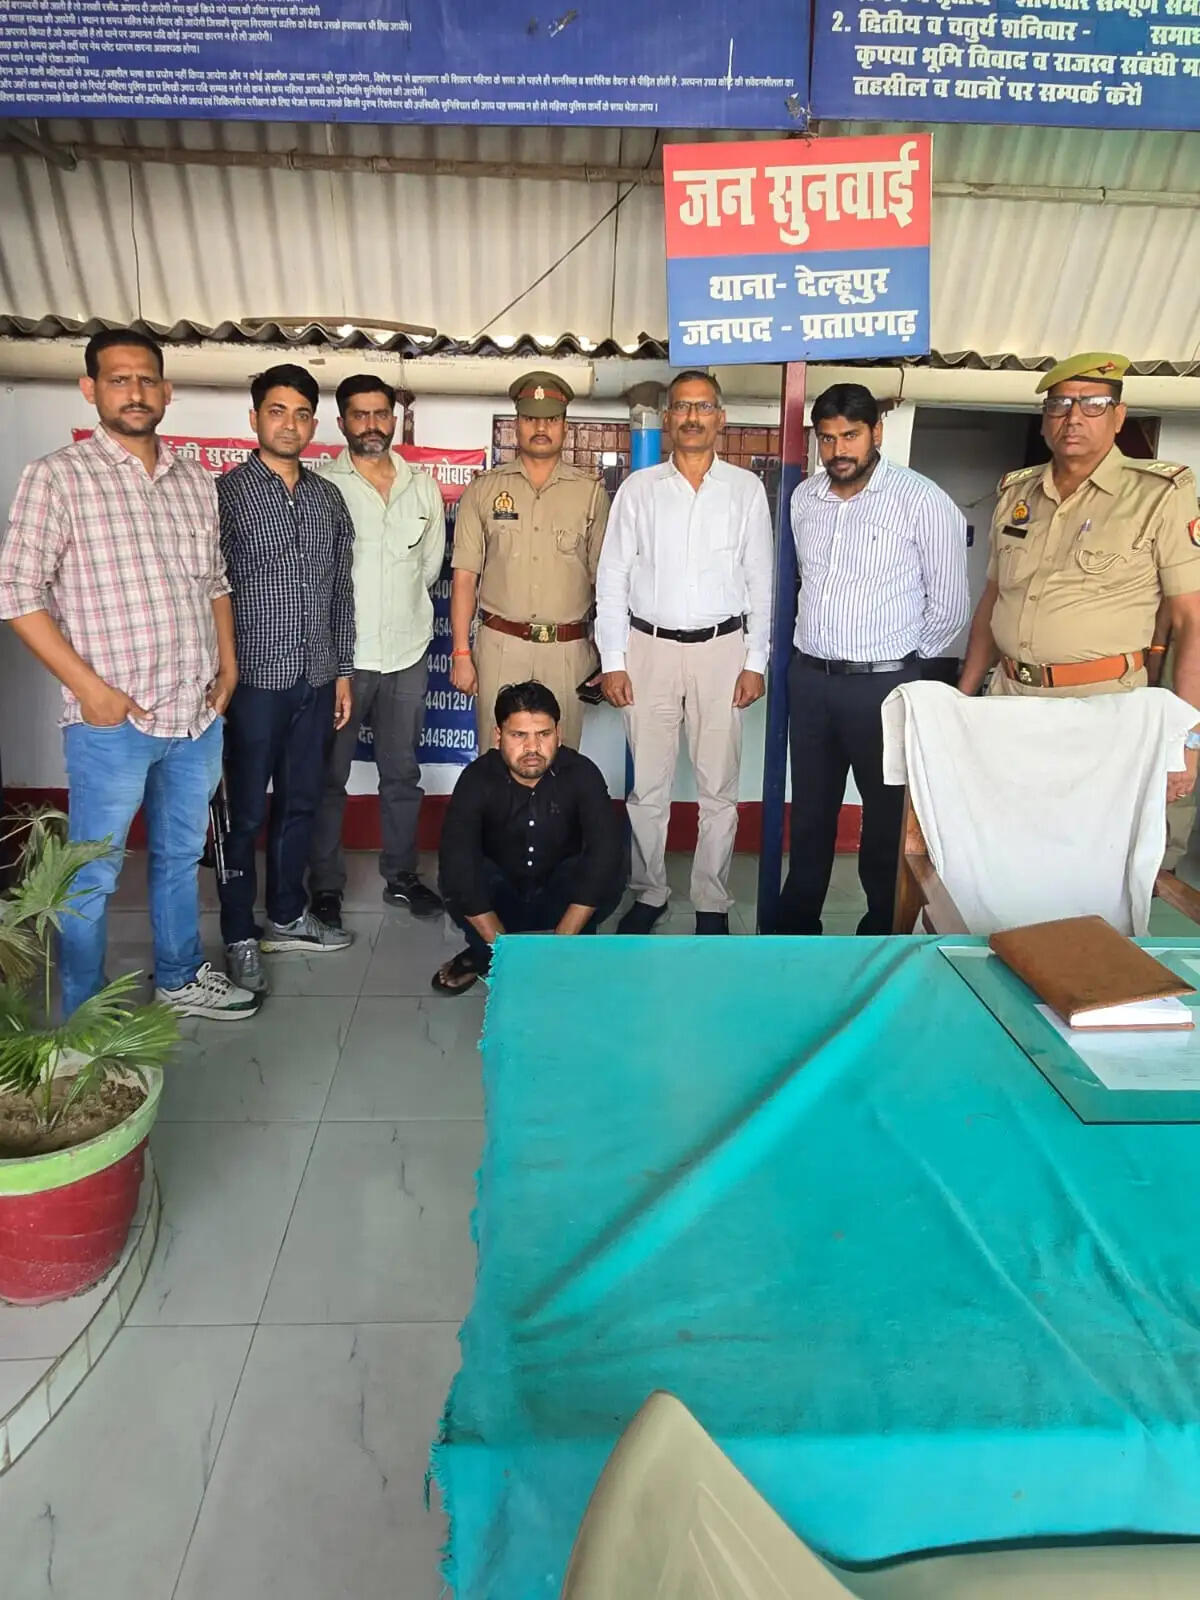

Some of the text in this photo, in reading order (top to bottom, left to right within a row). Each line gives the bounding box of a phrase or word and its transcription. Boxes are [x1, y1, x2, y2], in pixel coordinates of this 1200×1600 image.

[832, 11, 851, 32] 2.
[858, 9, 923, 34] द्वितीय
[926, 17, 944, 35] व
[947, 13, 998, 43] चतुर्थ
[1001, 15, 1078, 41] शनिवार
[855, 45, 917, 69] कृपया
[922, 43, 965, 73] भूमि
[968, 44, 1028, 69] विवाद
[1032, 52, 1050, 71] व
[1053, 53, 1117, 74] राजस्व
[853, 73, 930, 97] तहसील
[933, 79, 950, 98] व
[955, 76, 1006, 100] थानों
[1007, 82, 1035, 102] पर
[1038, 81, 1102, 105] सम्पर्क
[673, 141, 920, 246] जन सुनवाई
[794, 264, 891, 305] देल्हूपुर
[679, 317, 774, 346] जनपद
[800, 310, 919, 342] प्रतापगढ़
[436, 457, 484, 486] मोबाइ
